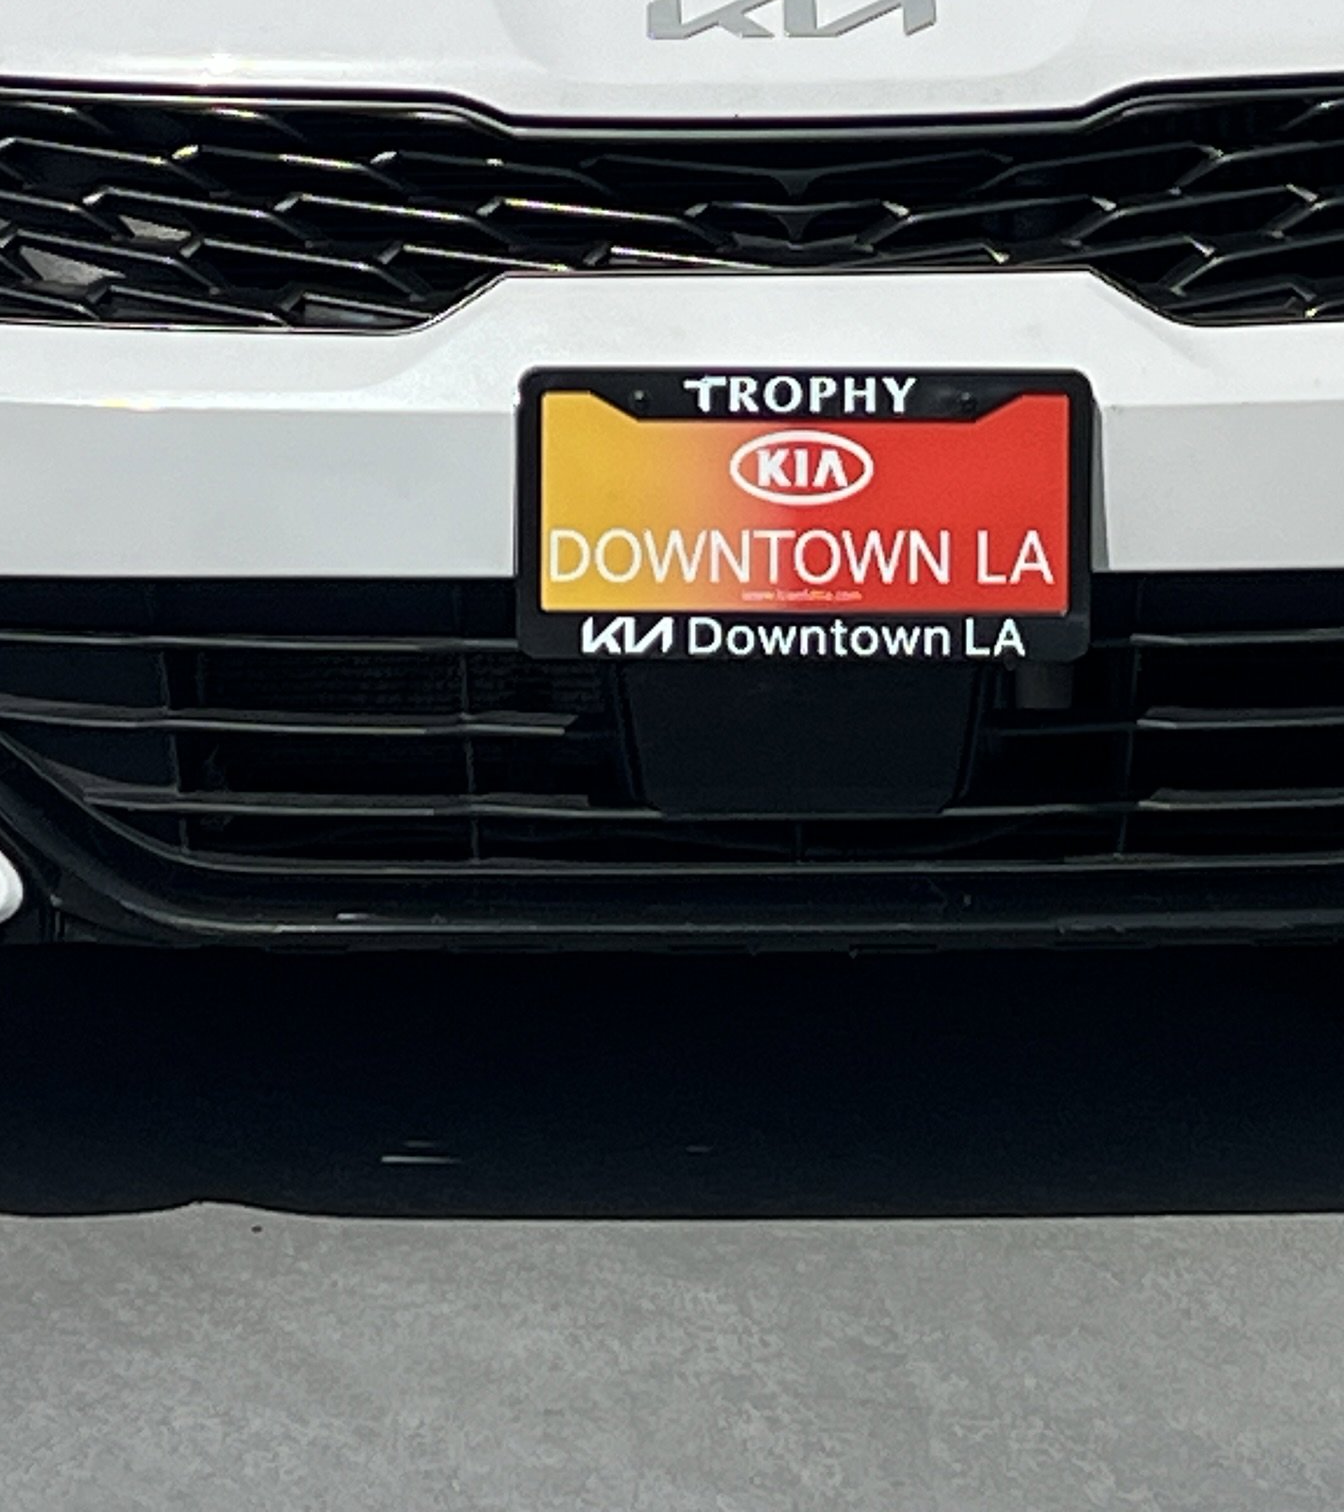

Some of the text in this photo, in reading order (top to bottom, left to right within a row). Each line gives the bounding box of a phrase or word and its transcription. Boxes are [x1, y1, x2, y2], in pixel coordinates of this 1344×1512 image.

[684, 376, 916, 413] TROPHY
[757, 449, 849, 488] KIA
[549, 529, 1054, 585] DOWNTOWN LA
[688, 618, 950, 656] Downtown
[965, 618, 1025, 656] LA
